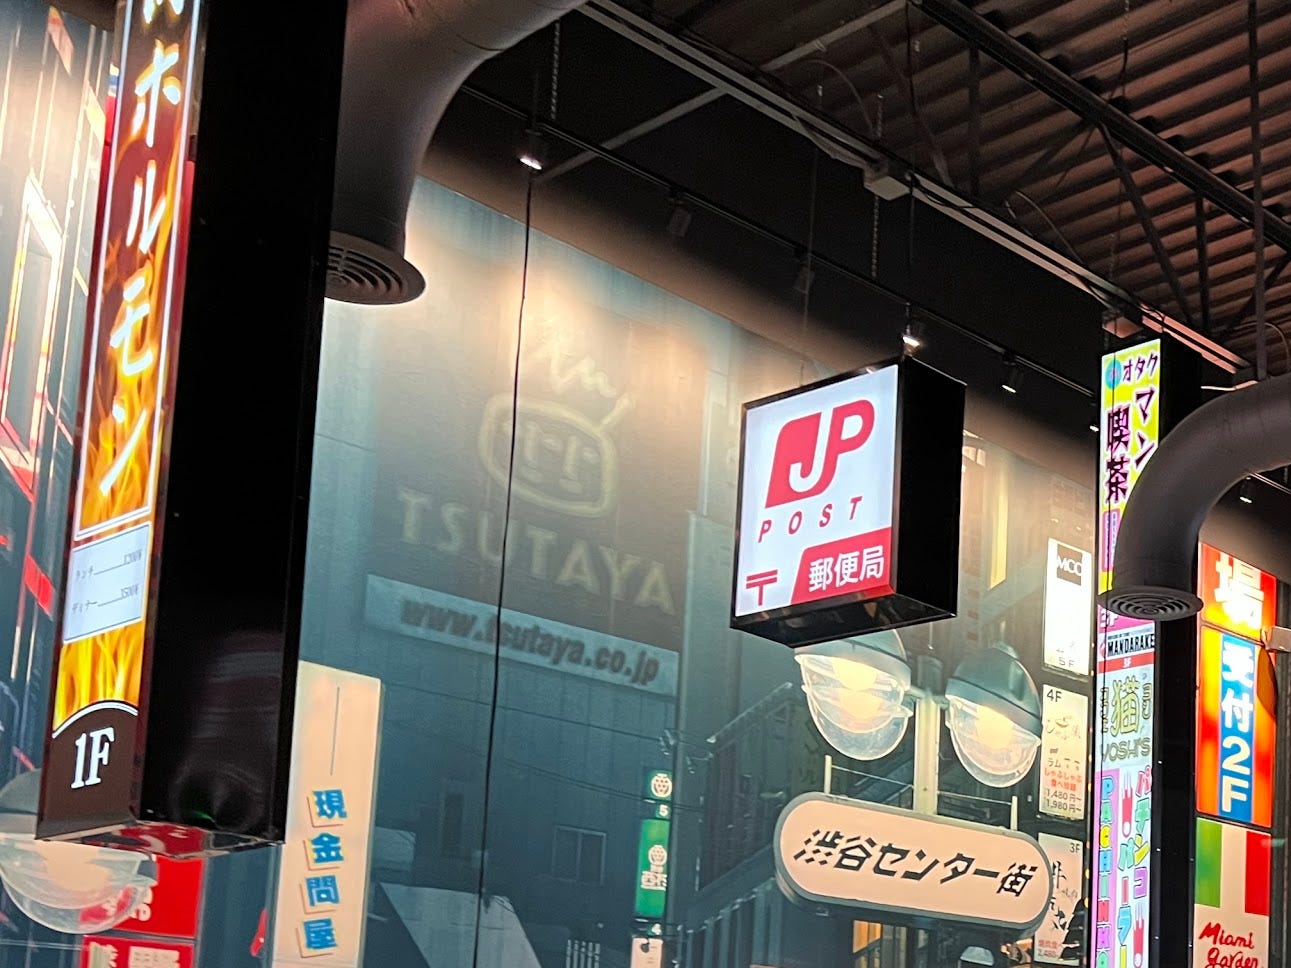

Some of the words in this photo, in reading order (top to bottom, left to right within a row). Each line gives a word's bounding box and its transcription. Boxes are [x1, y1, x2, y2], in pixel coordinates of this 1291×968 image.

[100, 0, 185, 494] ホルモン
[1122, 353, 1158, 382] オタク
[758, 496, 863, 543] POST
[399, 488, 677, 615] TSUTAYA
[808, 545, 884, 592] 郵便局
[1107, 633, 1155, 657] MANDARAKE
[1047, 689, 1062, 702] 4F
[70, 728, 115, 790] 1F
[303, 789, 348, 951] 現金問屋
[793, 828, 1038, 897] 渋谷センター街
[1198, 922, 1255, 950] Miami
